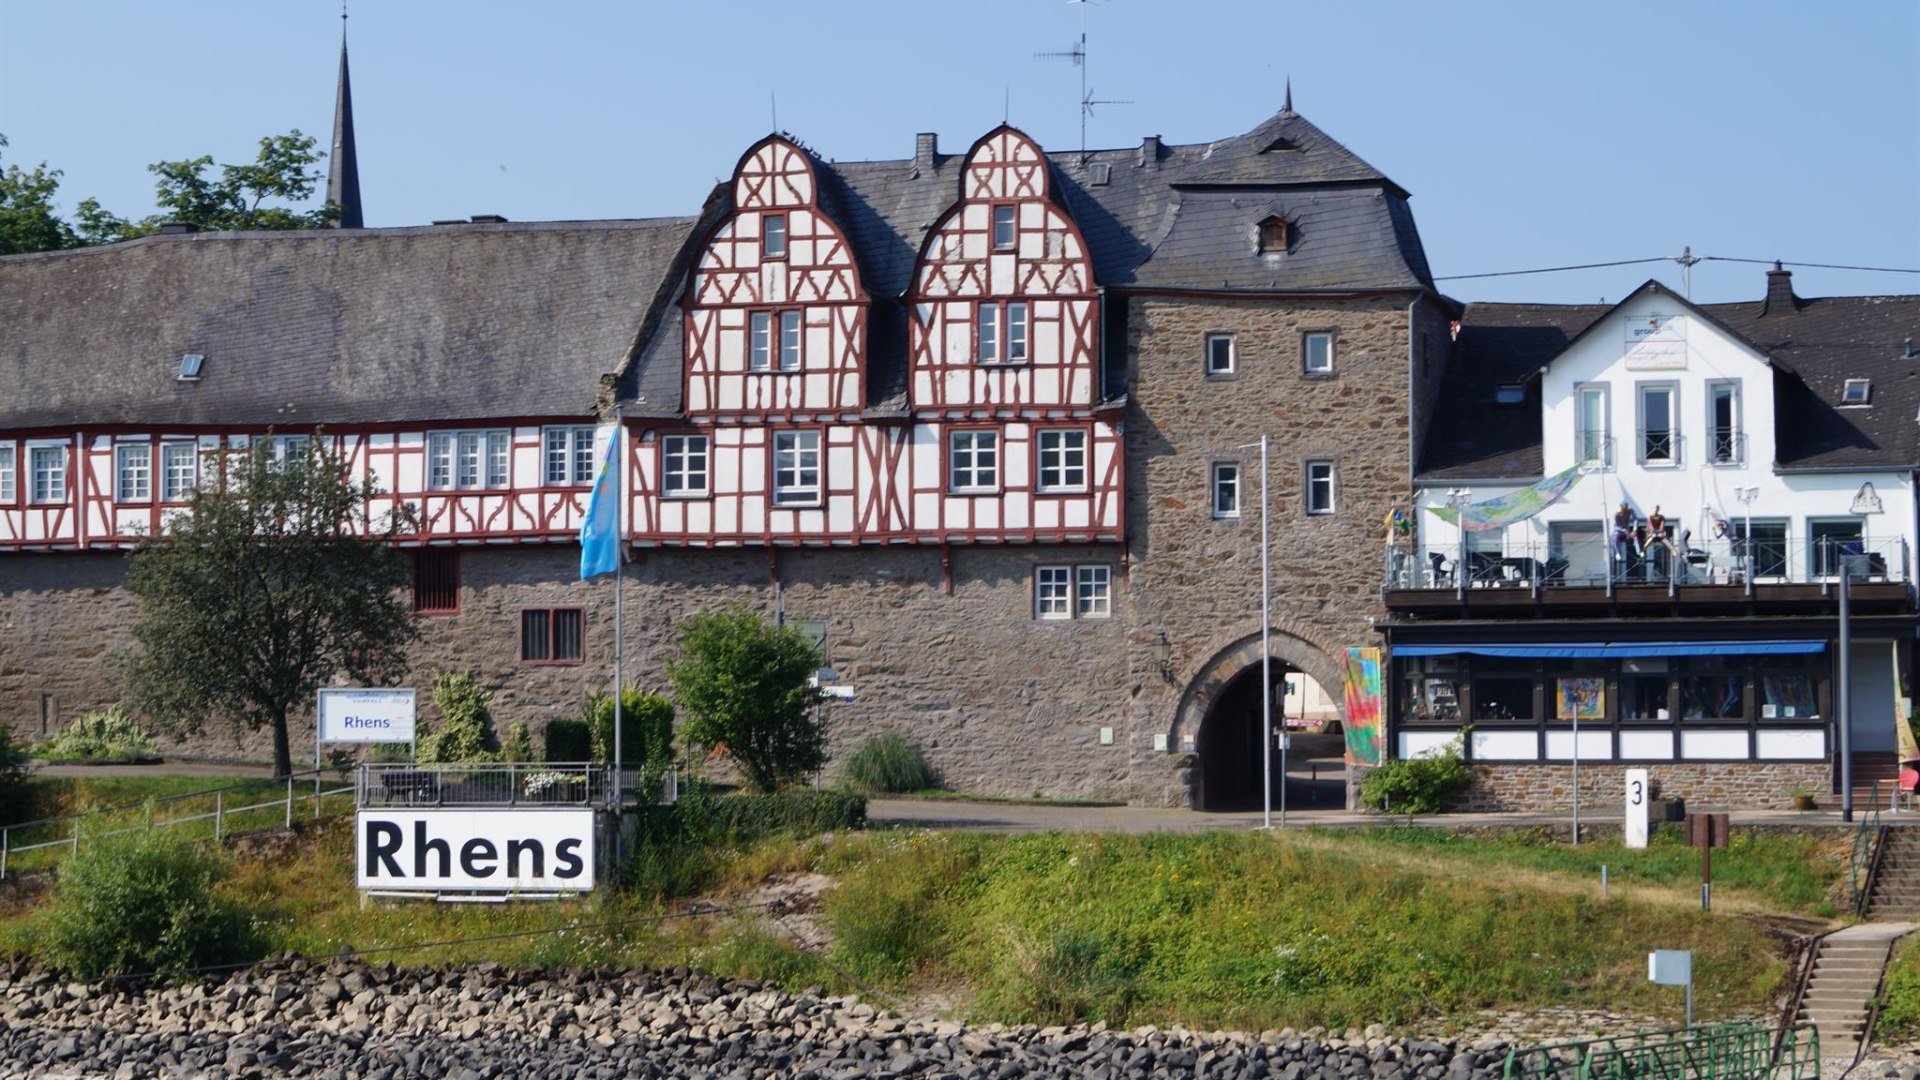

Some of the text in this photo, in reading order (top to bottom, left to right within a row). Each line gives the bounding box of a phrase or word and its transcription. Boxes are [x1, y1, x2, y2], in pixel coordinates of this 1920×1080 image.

[344, 716, 391, 728] Rhens
[1631, 780, 1642, 805] 3
[366, 820, 583, 878] Rhens
